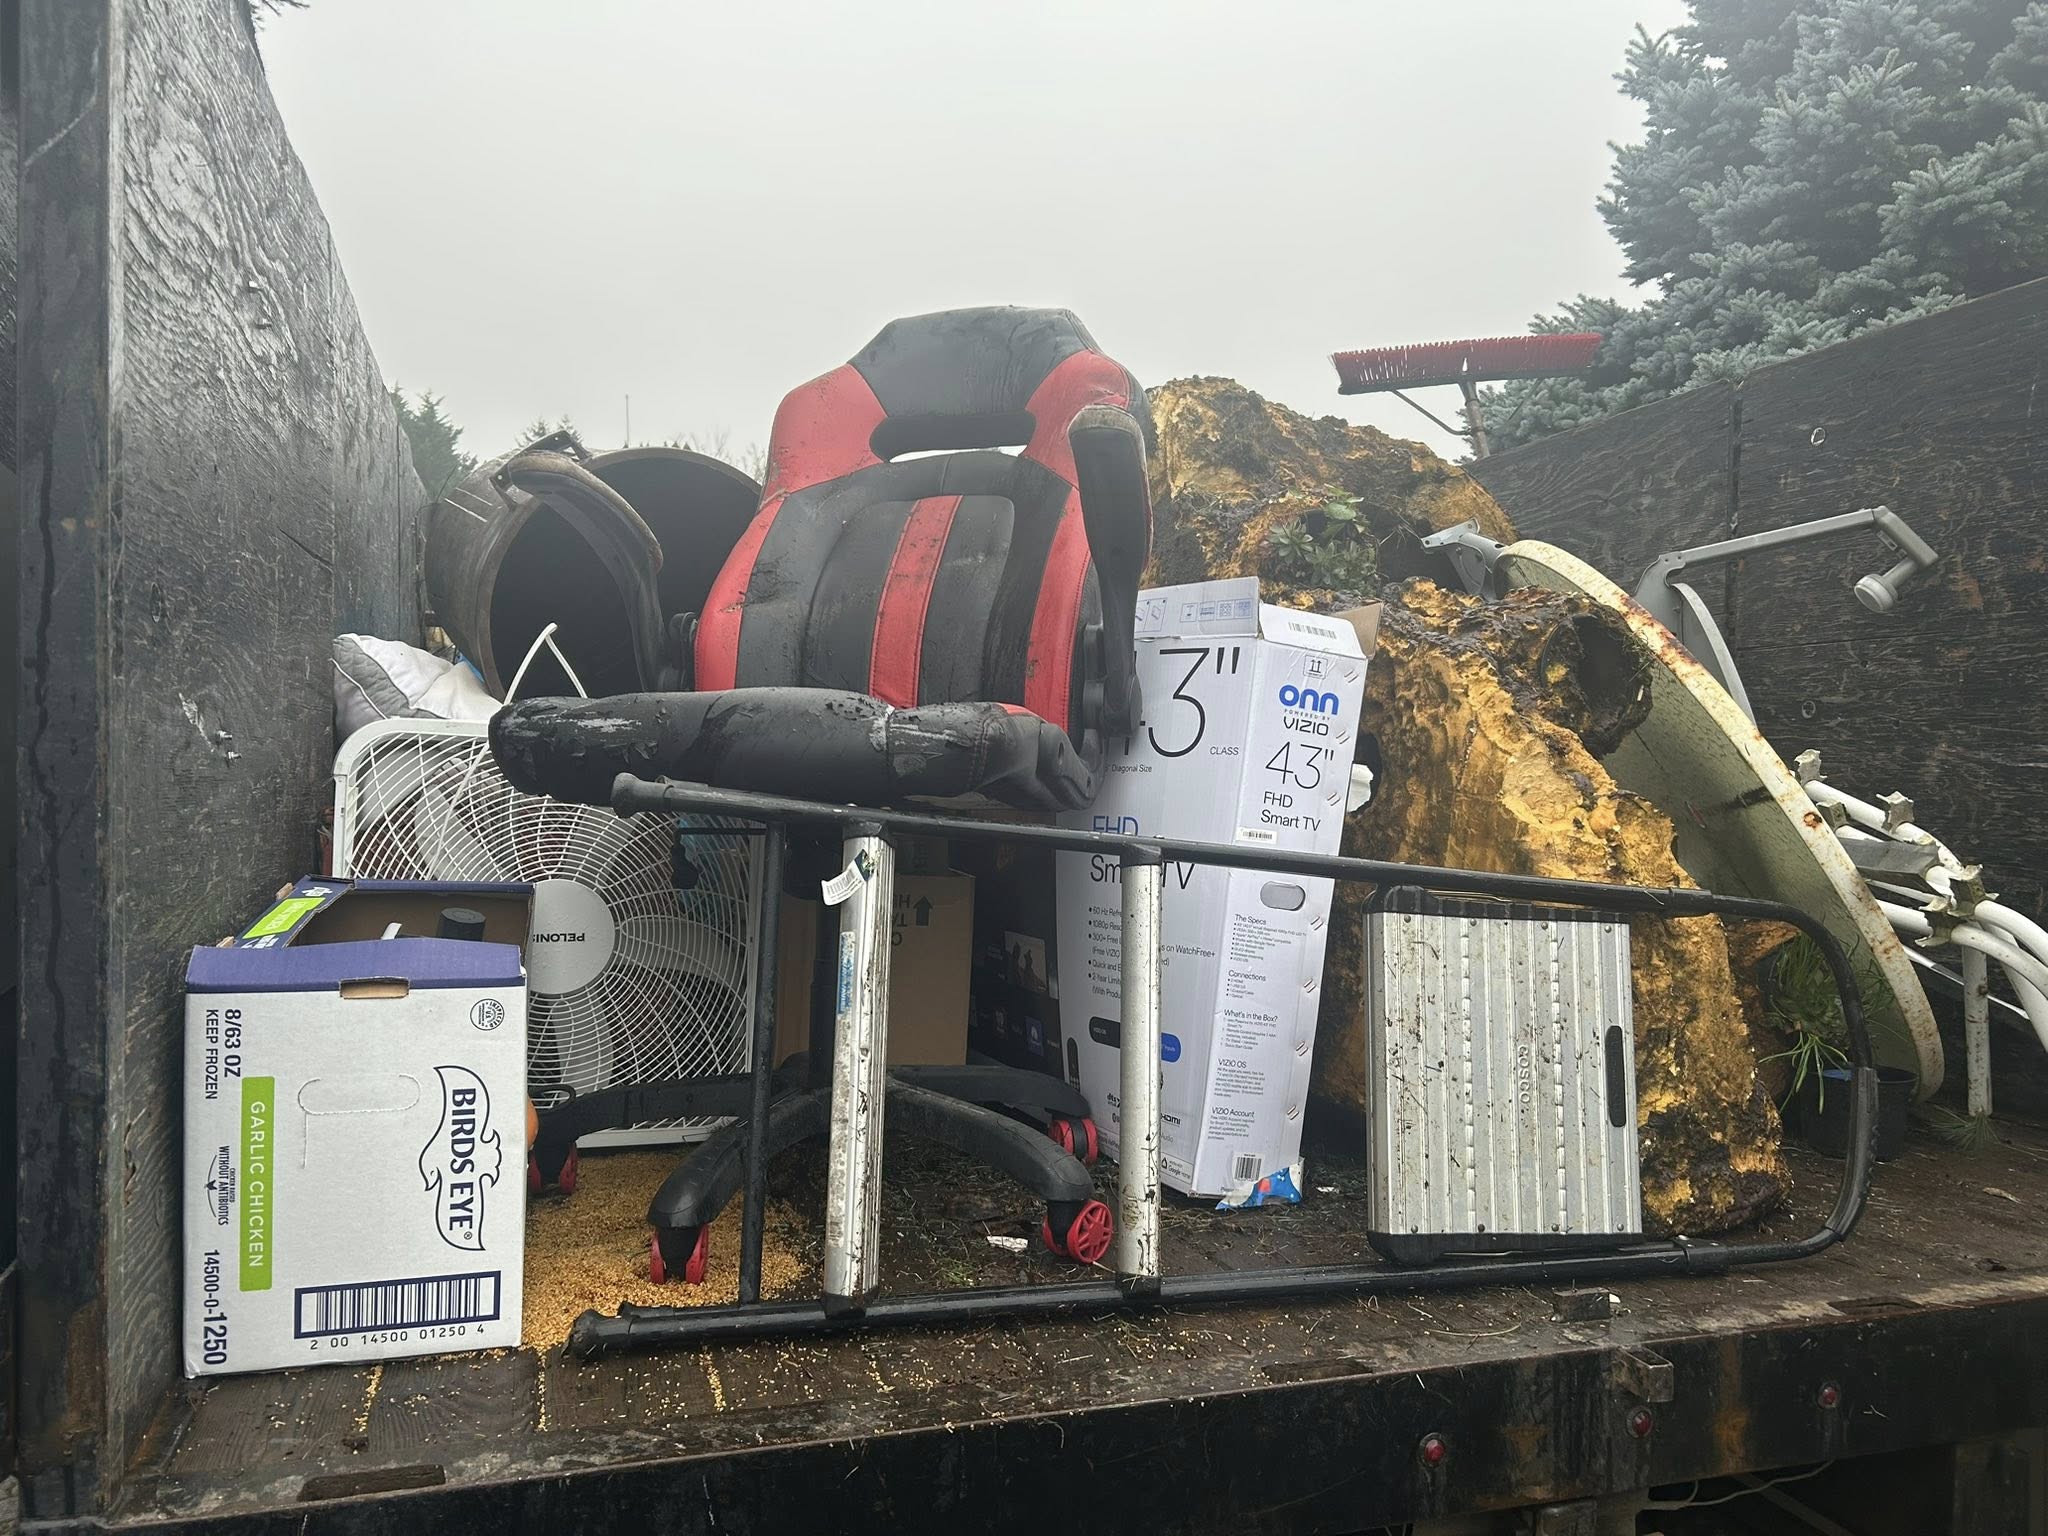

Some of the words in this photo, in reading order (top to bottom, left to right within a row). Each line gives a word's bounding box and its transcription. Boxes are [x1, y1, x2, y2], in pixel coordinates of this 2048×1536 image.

[1124, 645, 1240, 758] 3"
[1278, 684, 1339, 715] onn
[1283, 716, 1329, 736] VIZIO
[1209, 746, 1240, 756] CLASS
[1111, 763, 1138, 774] Diagonal
[1139, 763, 1152, 772] Size
[1265, 741, 1334, 789] 43"
[1263, 791, 1293, 808] FHD
[1093, 815, 1139, 836] FHD
[1260, 810, 1300, 829] Smart
[1302, 816, 1321, 831] TV
[1090, 854, 1122, 883] Sm
[1162, 860, 1196, 889] TV
[1235, 913, 1247, 922] The
[1247, 916, 1267, 926] Specs
[1107, 934, 1119, 944] Free
[1176, 945, 1215, 957] WatchFree+
[1092, 959, 1106, 969] Quick
[1107, 962, 1117, 971] and
[1228, 969, 1266, 981] Connections
[1106, 988, 1120, 998] Produ
[205, 1009, 219, 1044] KEEP
[1223, 1009, 1245, 1019] What's
[1252, 1013, 1262, 1021] the
[1263, 1014, 1278, 1022] Box?
[224, 1008, 242, 1049] 8/63
[205, 1048, 218, 1100] FROZEN
[224, 1054, 241, 1078] OZ
[1217, 1058, 1236, 1067] VIZIO
[1237, 1060, 1247, 1069] OS
[1212, 1106, 1229, 1116] VIZIO
[1229, 1108, 1255, 1118] Account
[249, 1101, 265, 1175] GARLIC
[449, 1088, 477, 1175] BIRDS
[218, 1145, 230, 1179] WITHOUT
[218, 1181, 229, 1226] ANTIBIOTICS
[248, 1180, 265, 1267] CHICKEN
[203, 1249, 228, 1365] 14500-0-1250
[310, 1340, 318, 1350] 2
[330, 1336, 349, 1348] 00
[361, 1330, 408, 1345] 14500
[419, 1325, 466, 1340] 01250
[477, 1323, 485, 1334] 4
